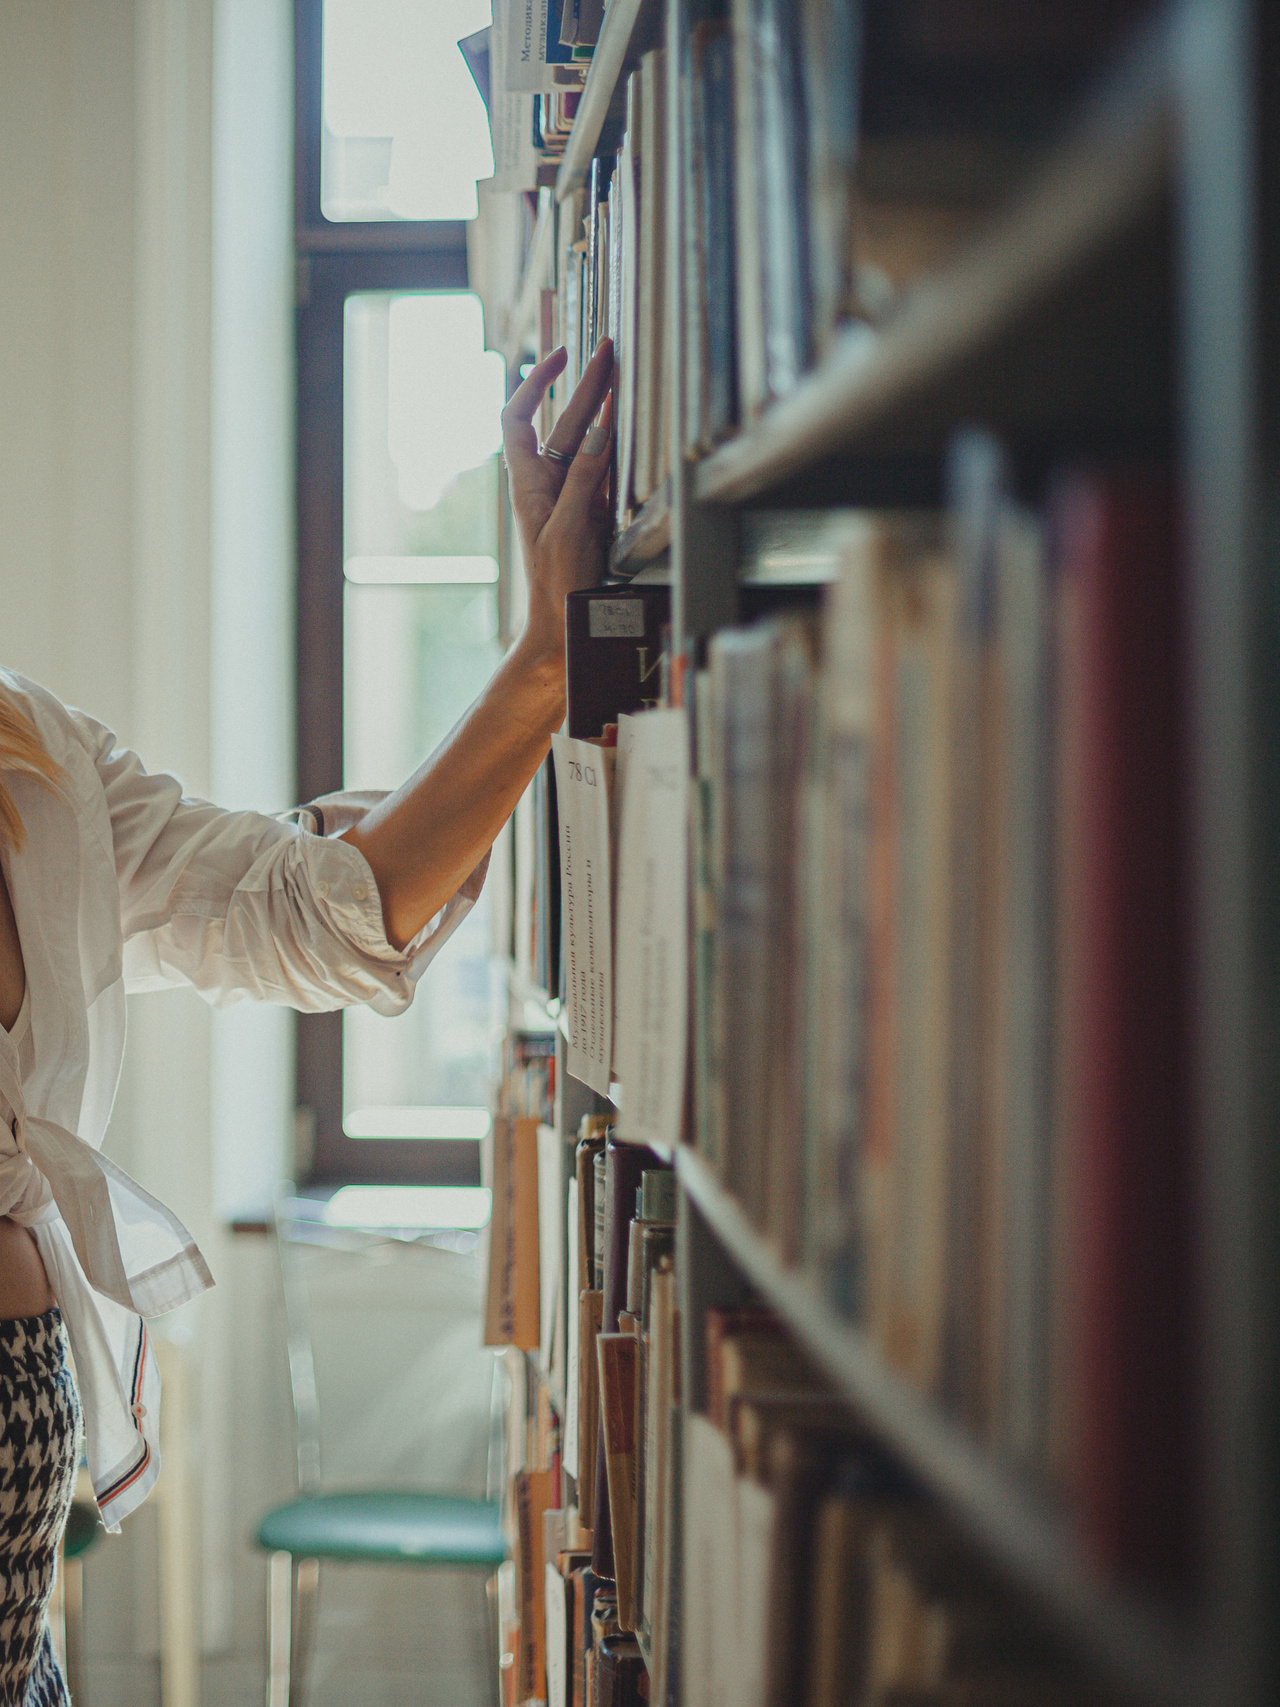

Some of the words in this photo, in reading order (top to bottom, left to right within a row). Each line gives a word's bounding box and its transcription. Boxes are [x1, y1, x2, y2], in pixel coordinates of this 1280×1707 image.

[566, 881, 577, 947] культура
[586, 873, 595, 974] композиторы
[570, 950, 580, 1049] Музыкальная
[581, 1037, 588, 1055] до
